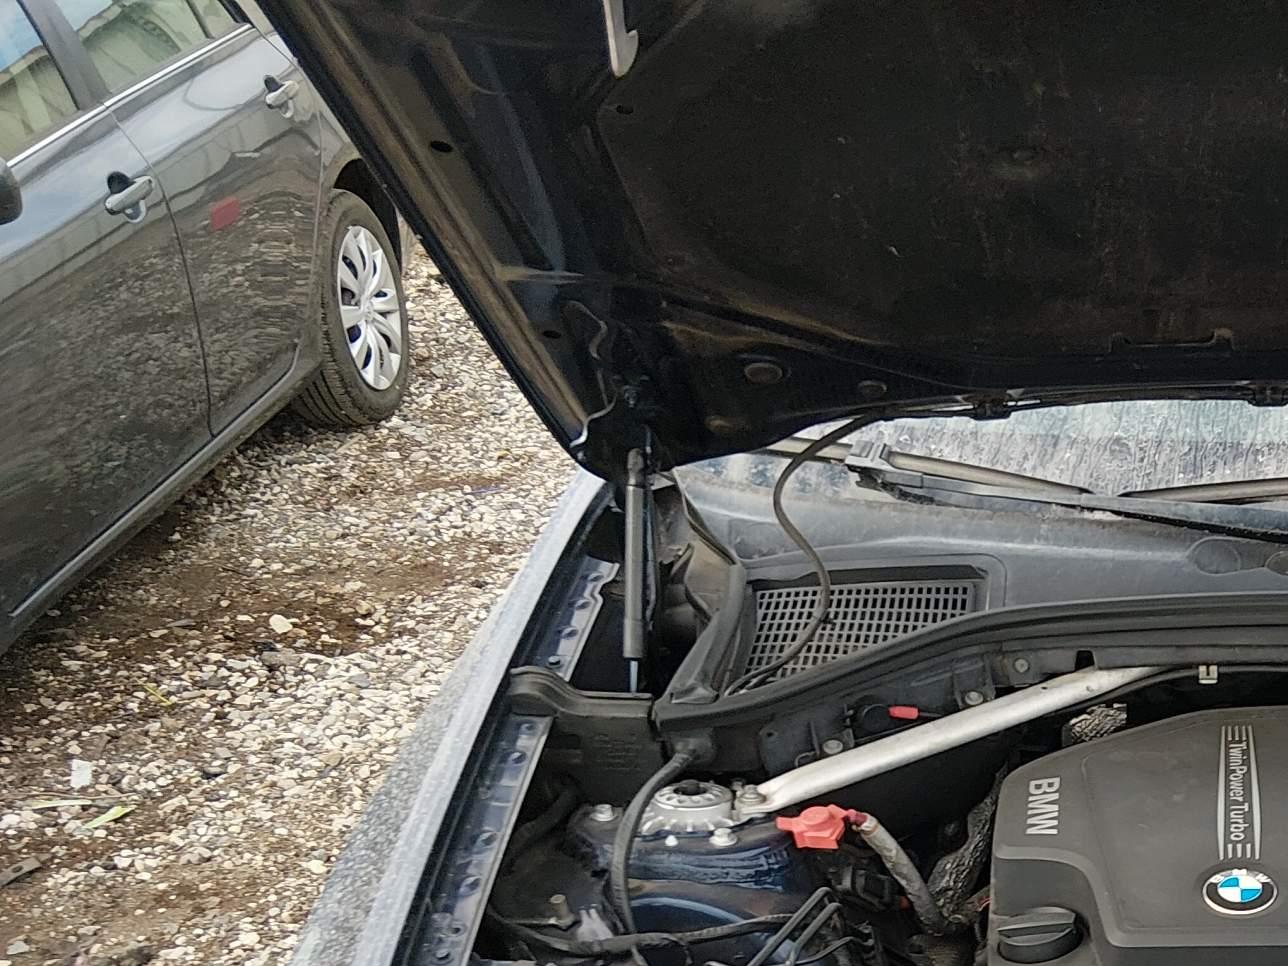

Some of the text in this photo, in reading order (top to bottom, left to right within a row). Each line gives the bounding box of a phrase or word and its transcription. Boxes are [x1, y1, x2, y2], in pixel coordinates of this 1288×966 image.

[1027, 776, 1061, 836] BMW
[1228, 741, 1249, 842] TwinPower Turbo
[1209, 868, 1272, 883] BMW
